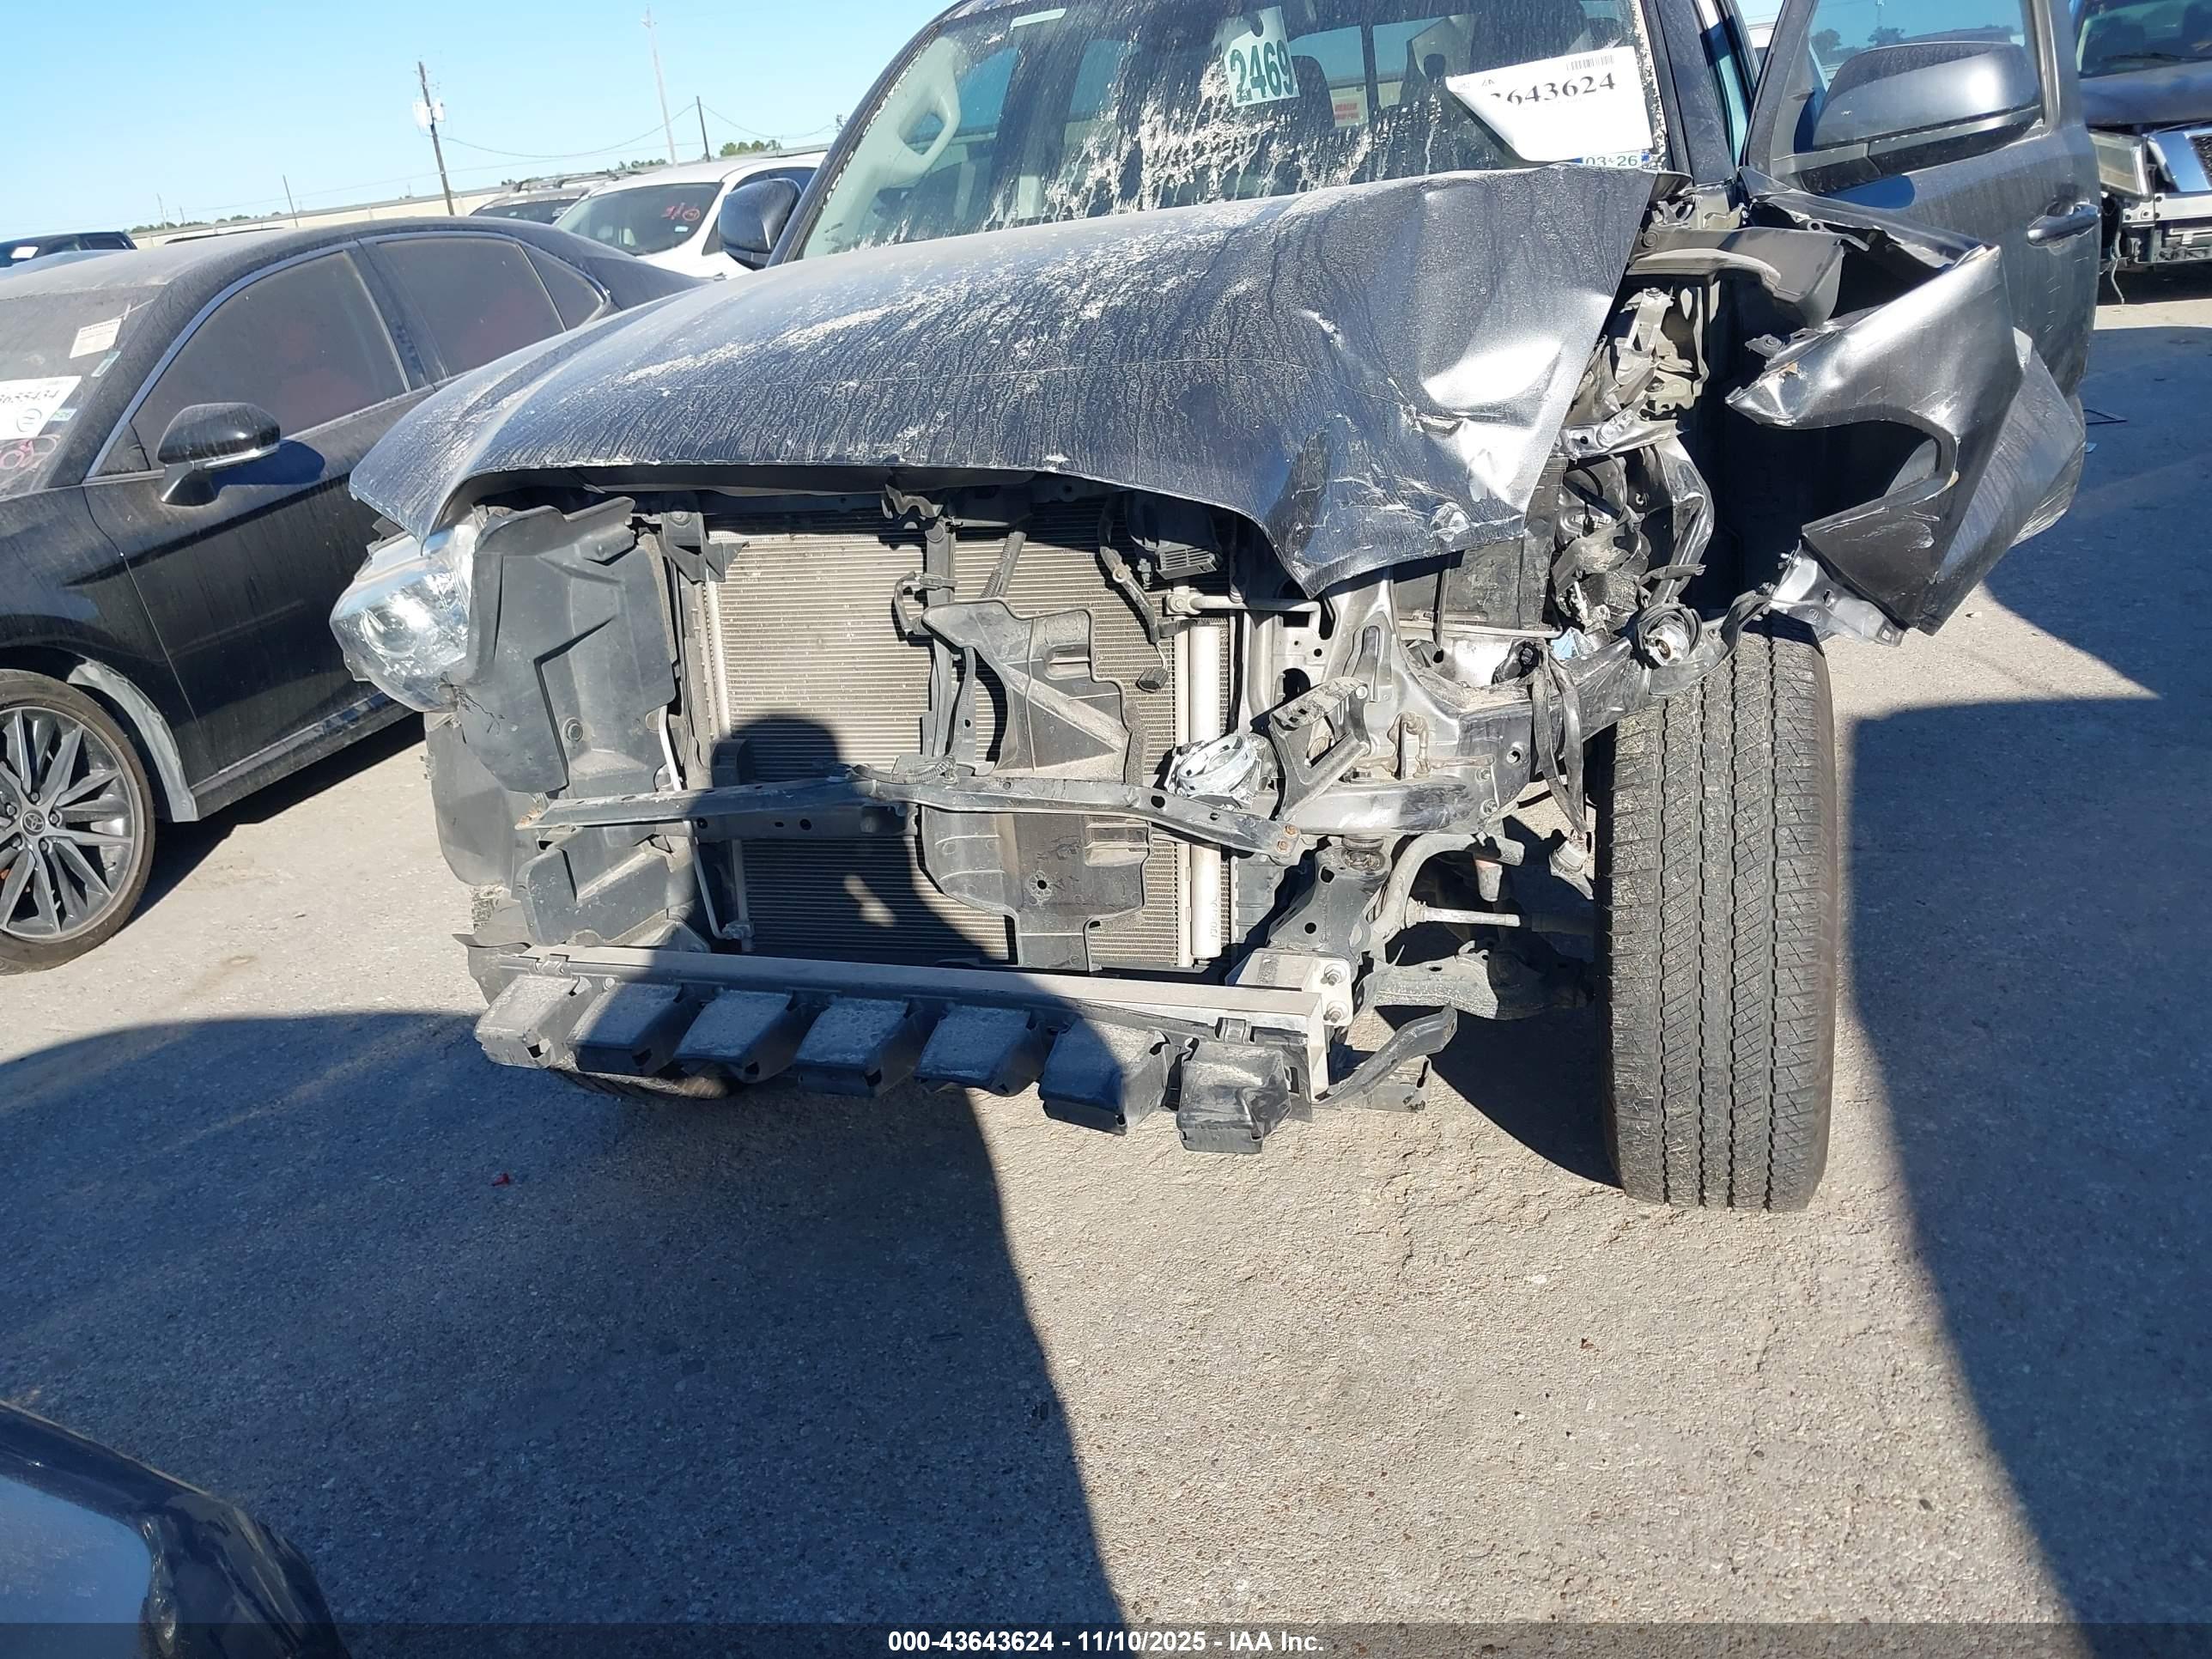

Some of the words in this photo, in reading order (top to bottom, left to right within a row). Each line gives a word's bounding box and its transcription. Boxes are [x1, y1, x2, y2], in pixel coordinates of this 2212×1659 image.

[1229, 40, 1294, 103] 2469
[1491, 72, 1616, 106] 643624
[1617, 155, 1638, 167] 26
